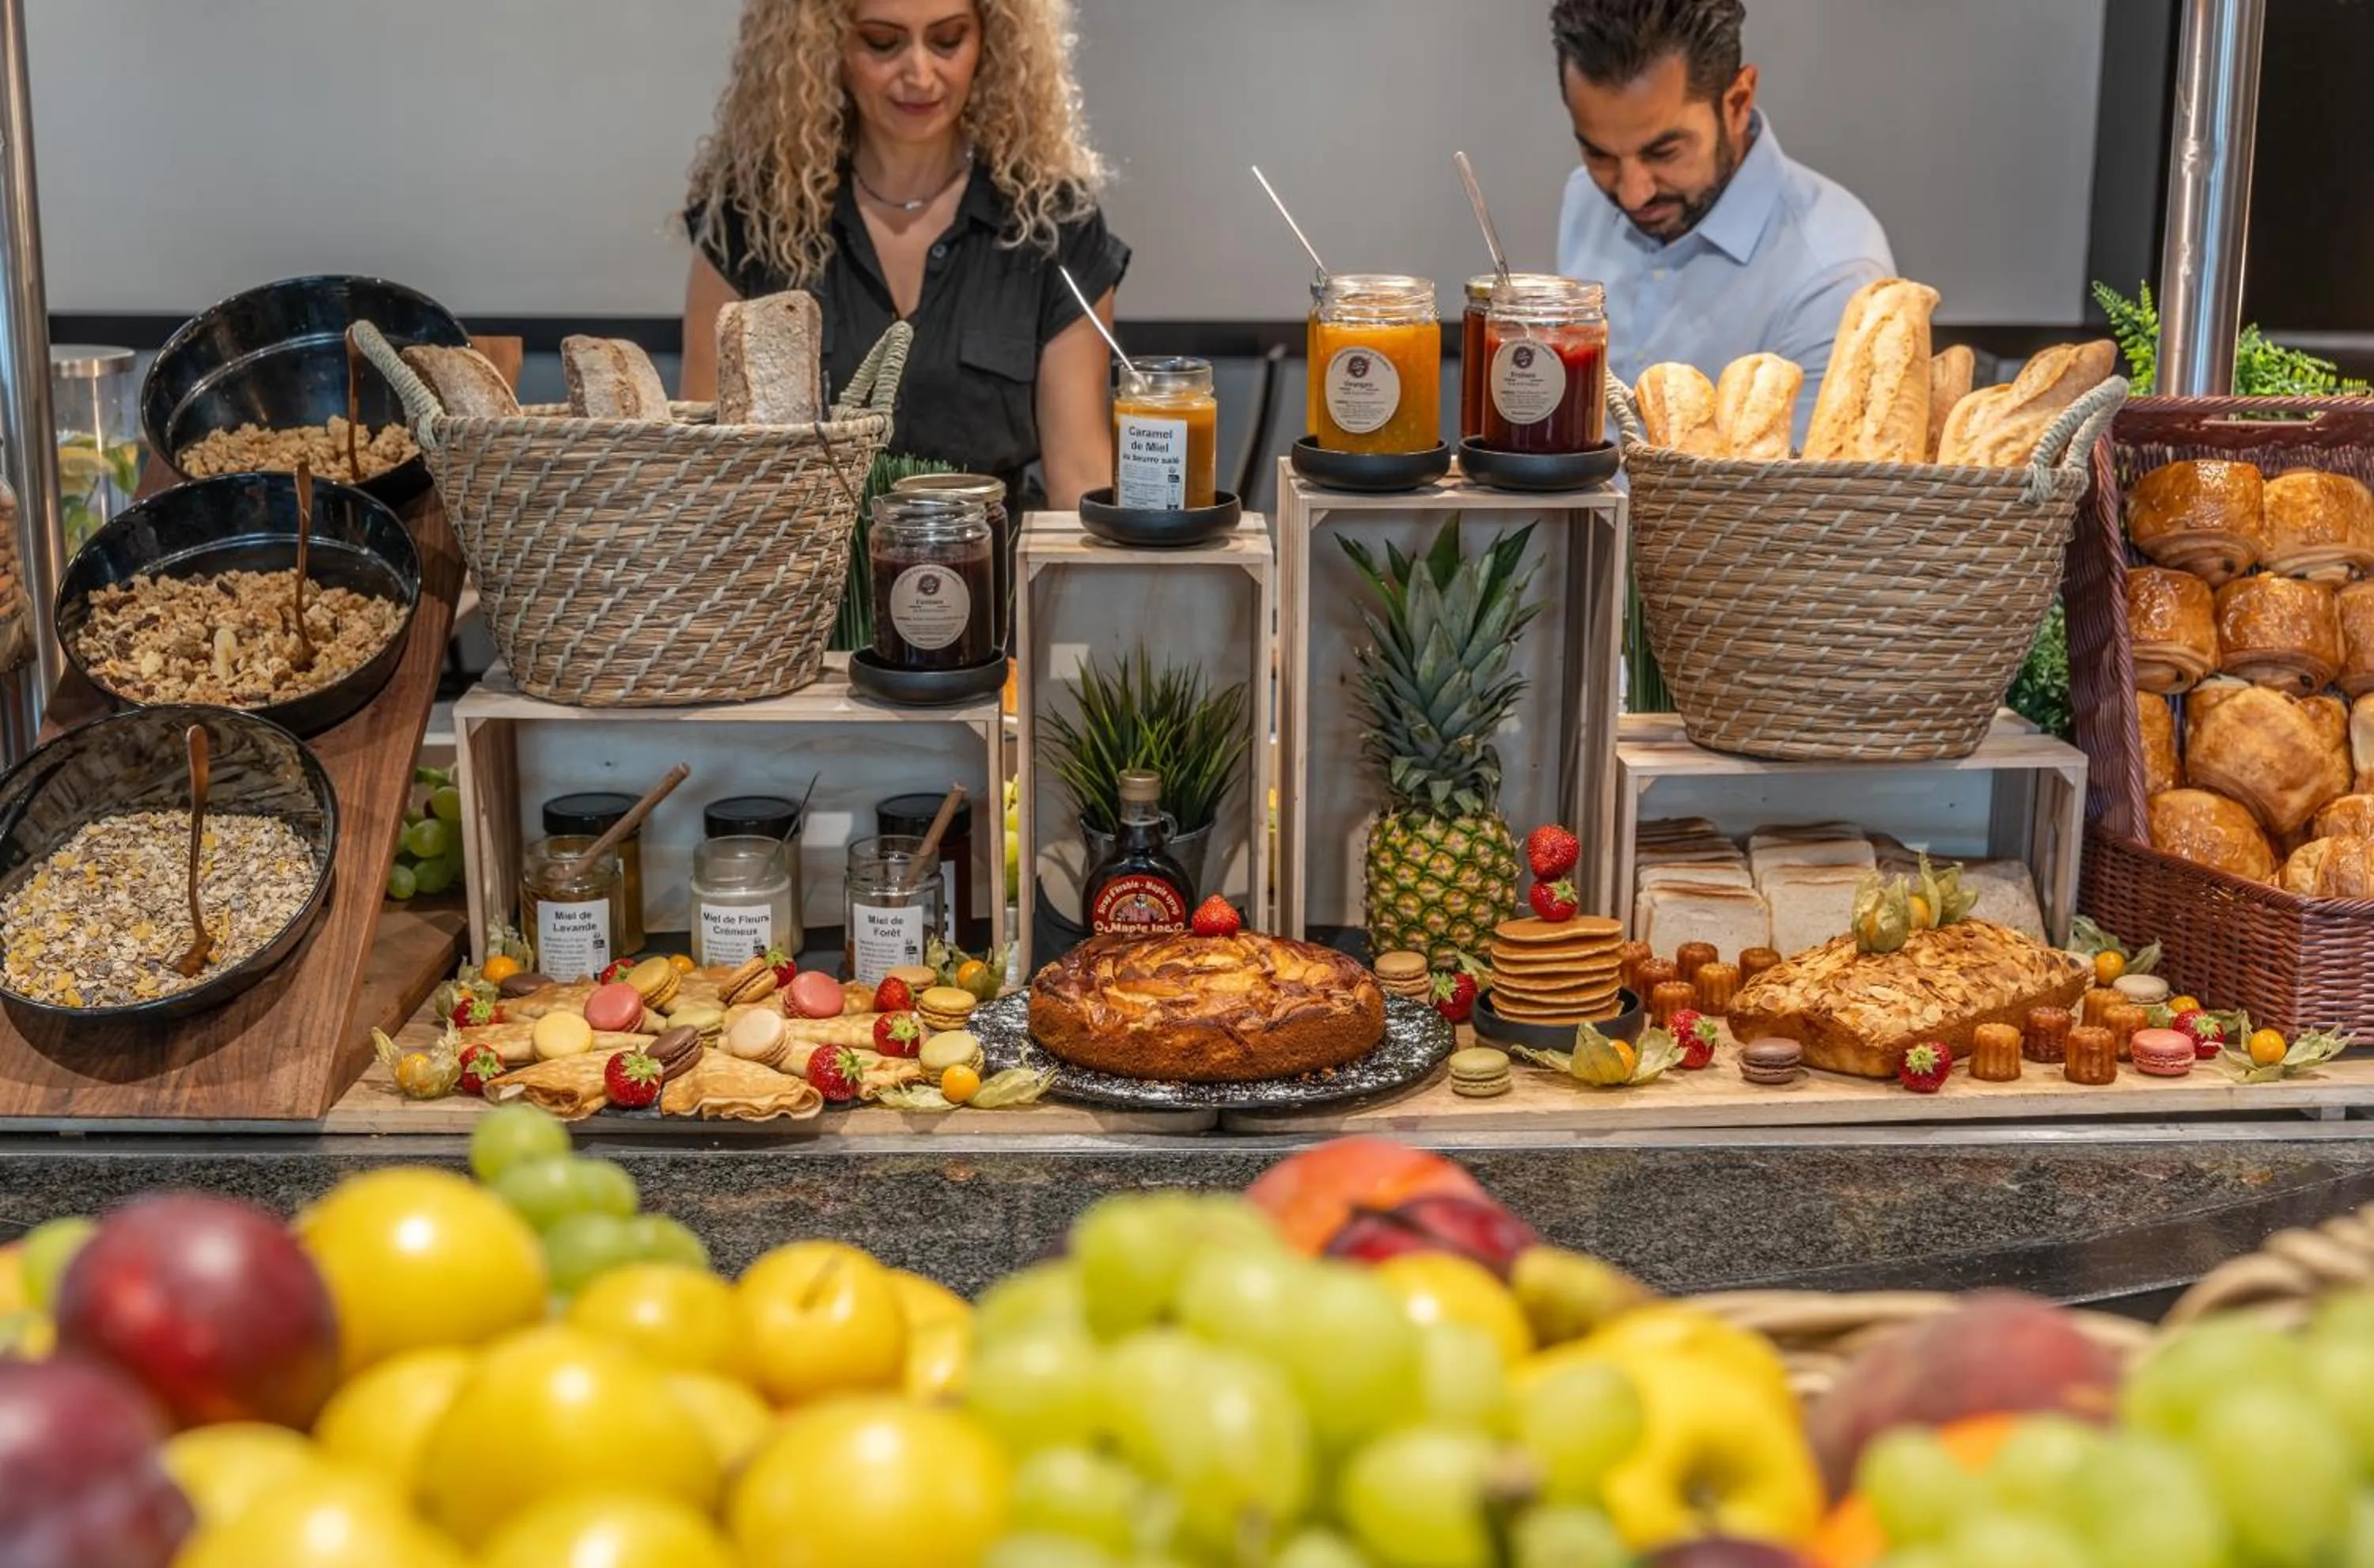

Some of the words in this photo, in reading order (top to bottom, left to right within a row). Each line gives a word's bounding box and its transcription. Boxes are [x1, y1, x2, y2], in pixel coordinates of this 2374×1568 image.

[1128, 426, 1174, 439] Caramel
[1131, 441, 1143, 450] de
[1145, 442, 1169, 453] Miel
[555, 911, 577, 920] Miel
[578, 911, 592, 920] de
[703, 911, 721, 923] Miel
[722, 915, 736, 924] de
[738, 915, 770, 925] Fleurs
[868, 915, 888, 925] Miel
[890, 916, 904, 925] de
[553, 922, 597, 932] Lavande
[874, 926, 901, 937] Forêt
[1105, 922, 1148, 934] Maple
